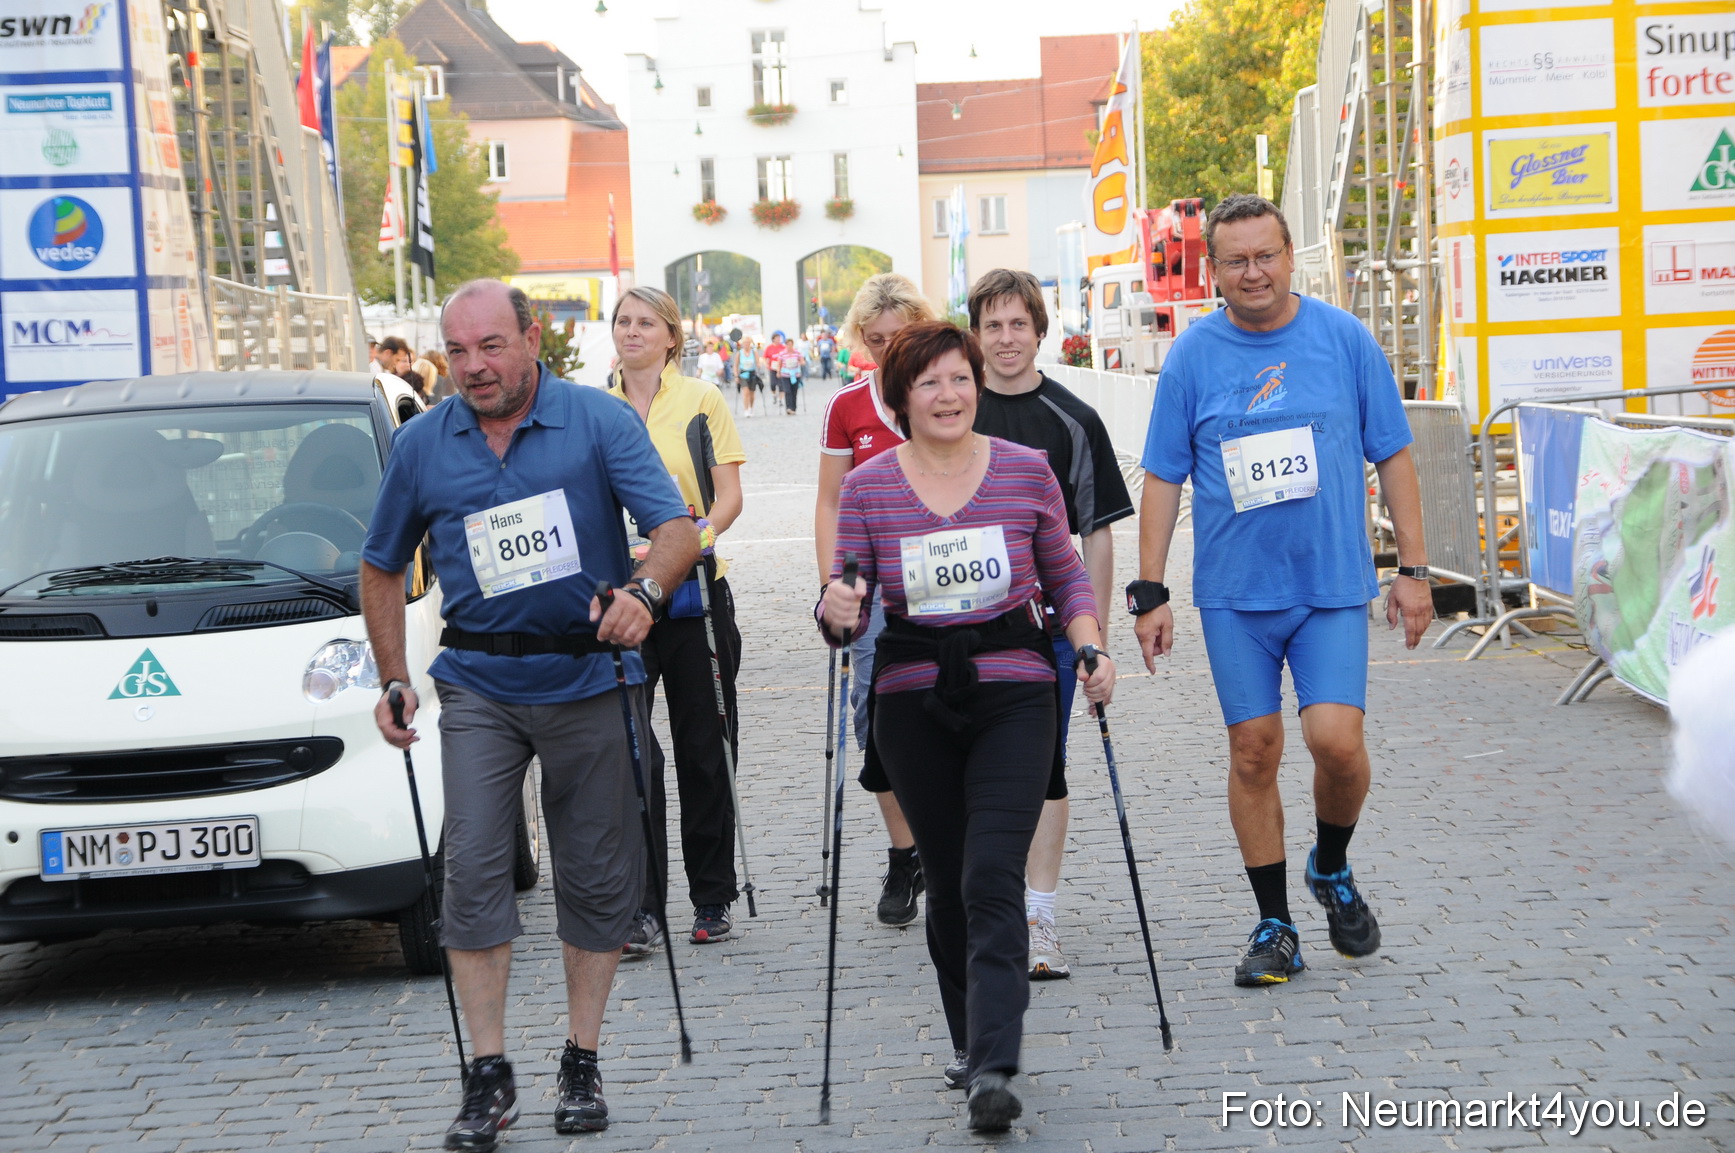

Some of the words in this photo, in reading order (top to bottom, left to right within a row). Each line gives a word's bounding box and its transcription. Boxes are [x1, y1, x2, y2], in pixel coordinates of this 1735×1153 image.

[0, 16, 72, 37] swn
[1645, 66, 1734, 97] forte
[1510, 143, 1590, 190] Glossner
[1552, 168, 1590, 186] Bier
[36, 242, 96, 262] vedes
[1515, 249, 1608, 266] INTERSPORT
[1500, 265, 1608, 286] HACKNER
[12, 319, 91, 344] MCM
[1534, 369, 1613, 379] VERSICHERUNGEN
[1262, 414, 1294, 424] marathon
[1229, 467, 1235, 477] N
[1251, 455, 1309, 481] 8123
[490, 512, 523, 530] Hans
[473, 545, 480, 557] N
[498, 525, 562, 561] 8081
[928, 536, 968, 557] Ingrid
[541, 560, 579, 576] PFLEIDERER
[908, 569, 916, 581] N
[935, 558, 1001, 587] 8080
[66, 833, 112, 867] NM
[137, 829, 181, 863] PJ
[191, 823, 253, 859] 300
